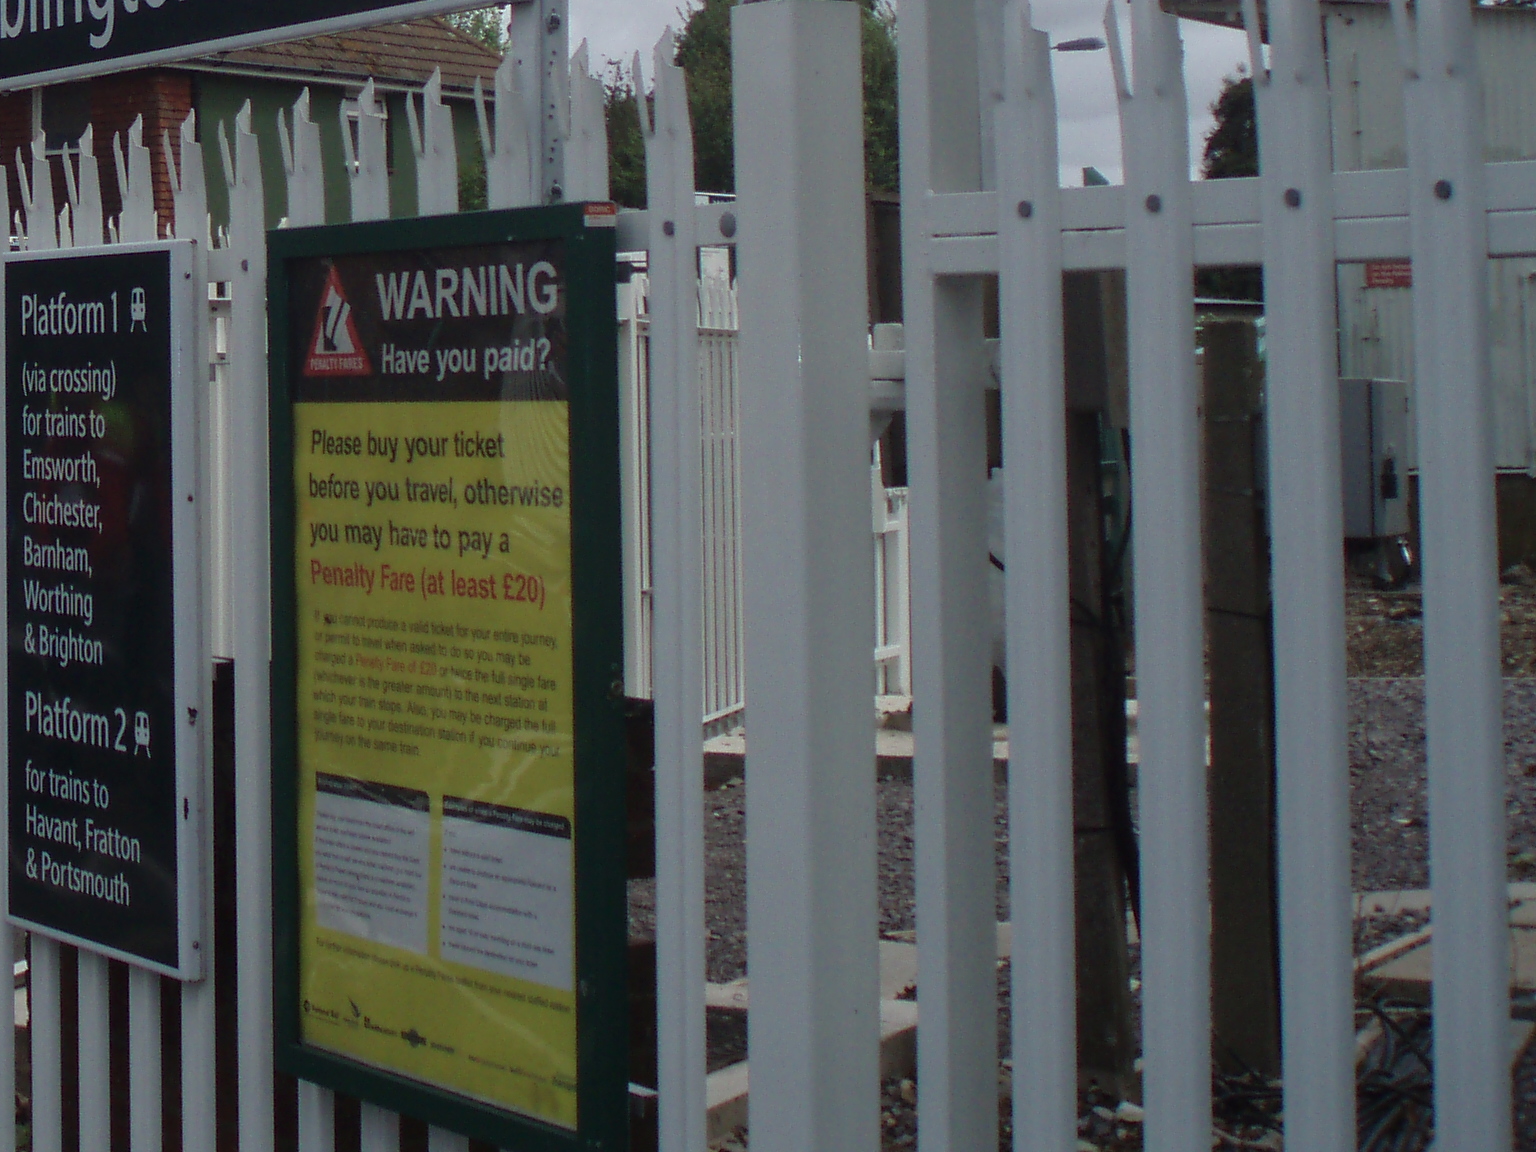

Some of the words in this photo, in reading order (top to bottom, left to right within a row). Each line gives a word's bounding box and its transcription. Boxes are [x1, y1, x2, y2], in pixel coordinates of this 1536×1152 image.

[375, 261, 558, 321] WARNING
[21, 292, 105, 336] Platform
[111, 291, 118, 333] 1
[22, 361, 46, 397] (via
[50, 359, 116, 401] crossing)
[381, 343, 430, 375] Have
[436, 346, 476, 381] you
[484, 337, 551, 380] paid?
[22, 404, 42, 436] for
[45, 406, 86, 438] trains
[89, 409, 105, 438] to
[311, 429, 362, 455] Please
[367, 431, 398, 463] buy
[404, 435, 448, 463] your
[454, 431, 506, 459] ticket
[23, 449, 101, 489] Emsworth,
[309, 472, 360, 499] before
[365, 480, 399, 507] you
[405, 477, 458, 509] travel,
[464, 477, 564, 508] otherwise
[23, 492, 103, 535] Chichester,
[23, 535, 93, 579] Barnham,
[309, 522, 339, 547] you
[345, 524, 382, 551] may
[389, 520, 427, 549] have
[432, 524, 451, 549] to
[458, 529, 492, 560] pay
[499, 532, 510, 553] a
[23, 579, 93, 626] Worthing
[310, 559, 375, 595] Penalty
[380, 563, 415, 590] Fare
[421, 567, 445, 601] (at
[451, 569, 498, 600] least
[503, 574, 546, 610] £20)
[24, 622, 36, 655] &
[39, 625, 103, 667] Brighton
[450, 645, 462, 658] do
[464, 649, 475, 660] so
[477, 650, 493, 663] you
[496, 652, 515, 667] may
[518, 653, 531, 666] be
[471, 628, 491, 641] your
[493, 629, 519, 643] entire
[385, 656, 405, 672] Fare
[537, 676, 557, 691] fare
[431, 707, 447, 720] you
[449, 709, 467, 725] may
[469, 710, 482, 724] be
[484, 712, 522, 731] charged
[524, 717, 539, 731] the
[465, 688, 480, 703] the
[482, 692, 501, 706] next
[504, 694, 535, 710] station
[25, 691, 109, 748] Platform
[114, 707, 127, 752] 2
[478, 736, 495, 750] you
[25, 759, 46, 794] for
[49, 766, 90, 804] trains
[93, 778, 109, 810] to
[26, 803, 81, 853] Havant,
[85, 818, 141, 864] Fratton
[26, 847, 38, 879] &
[42, 851, 130, 907] Portsmouth
